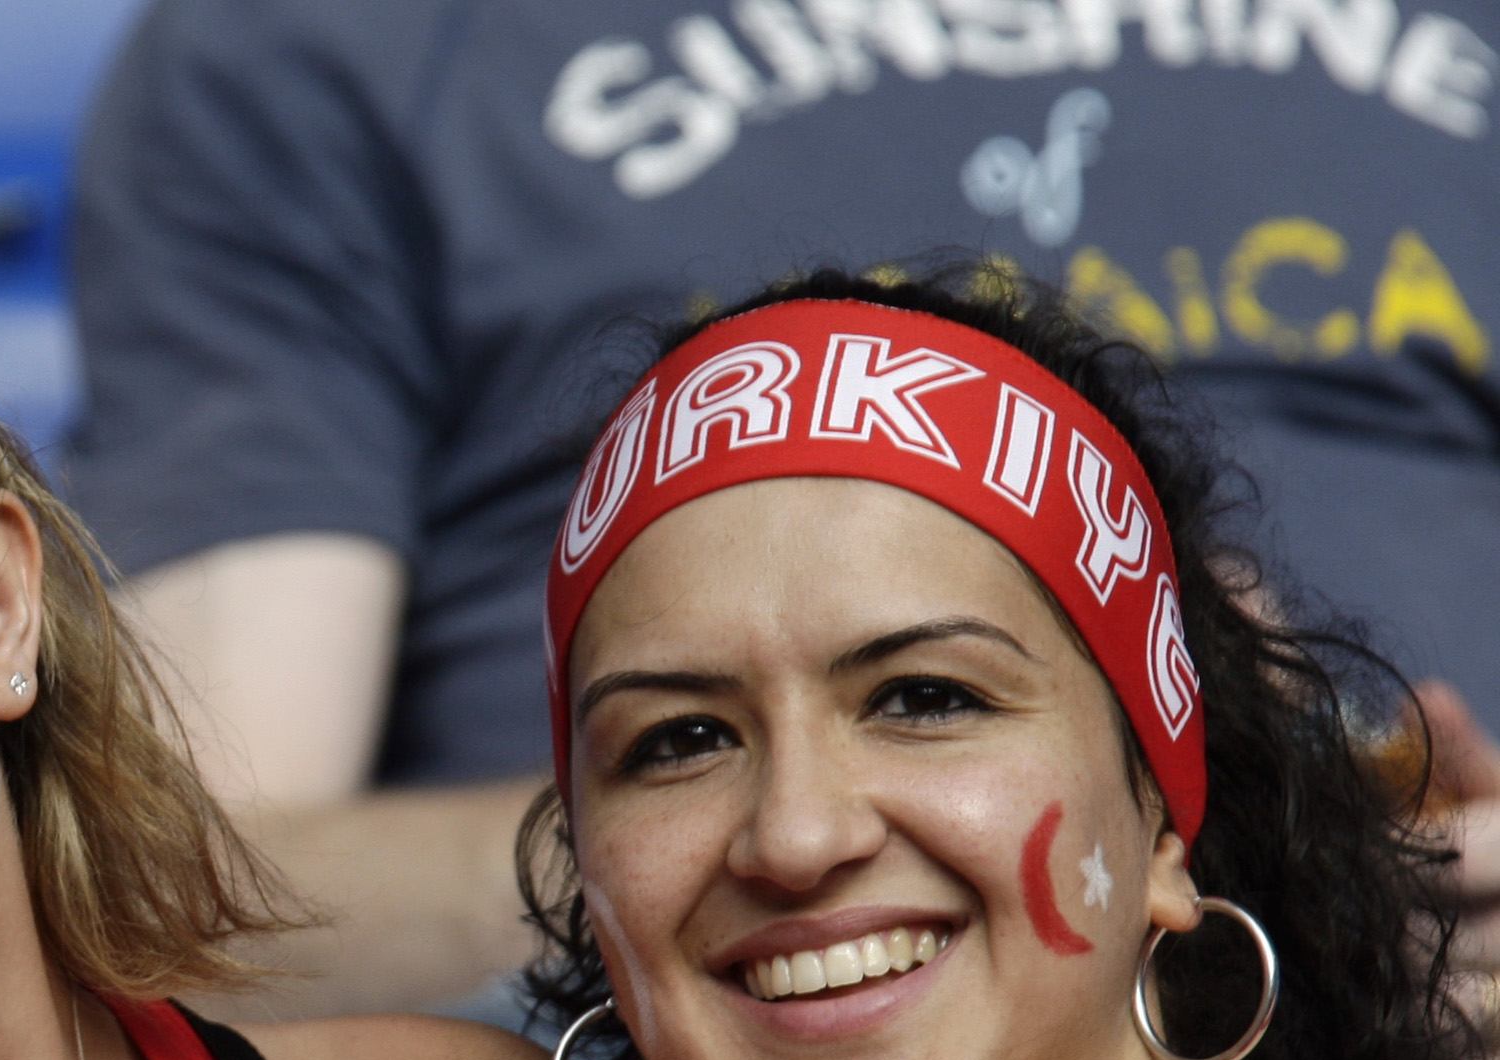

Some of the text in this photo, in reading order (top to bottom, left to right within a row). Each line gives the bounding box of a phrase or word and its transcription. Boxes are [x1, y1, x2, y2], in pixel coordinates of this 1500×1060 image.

[543, 0, 1497, 200] SUNSHINE
[959, 86, 1113, 248] of
[546, 332, 1200, 743] ÜRKIYE
